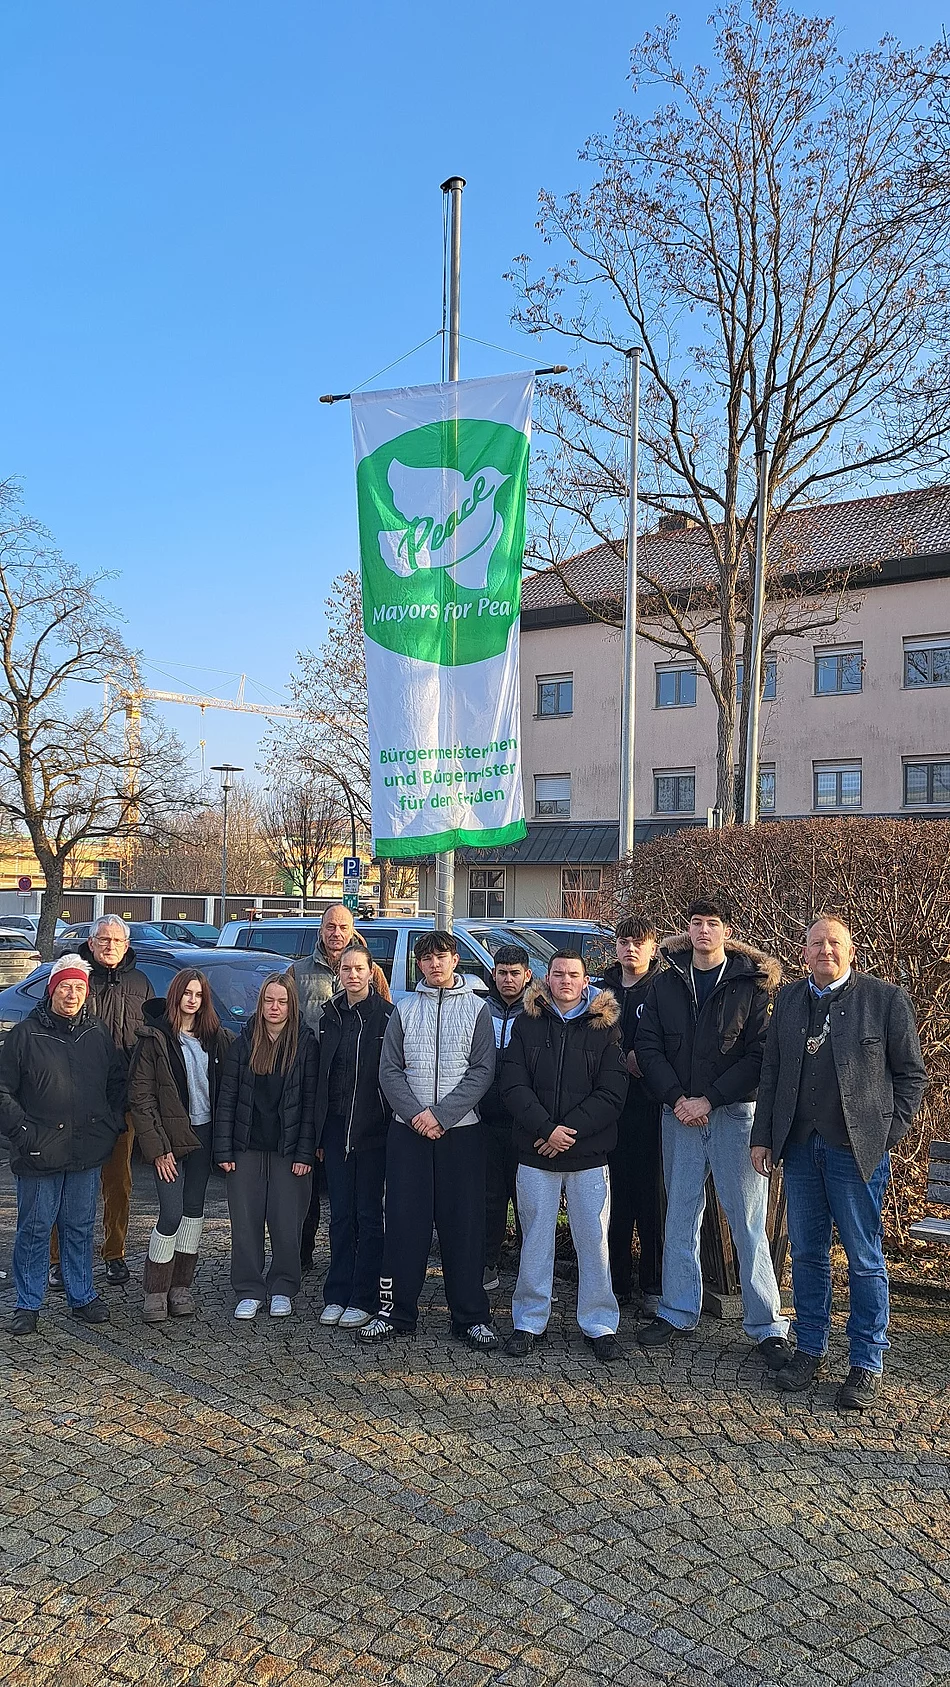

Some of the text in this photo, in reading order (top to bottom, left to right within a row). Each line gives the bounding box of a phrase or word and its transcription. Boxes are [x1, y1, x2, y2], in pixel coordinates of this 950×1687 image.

[397, 476, 495, 569] Peace
[372, 598, 513, 625] Mayors for Pea
[384, 770, 417, 787] und
[399, 795, 426, 811] für
[430, 792, 454, 809] den
[347, 859, 356, 875] P
